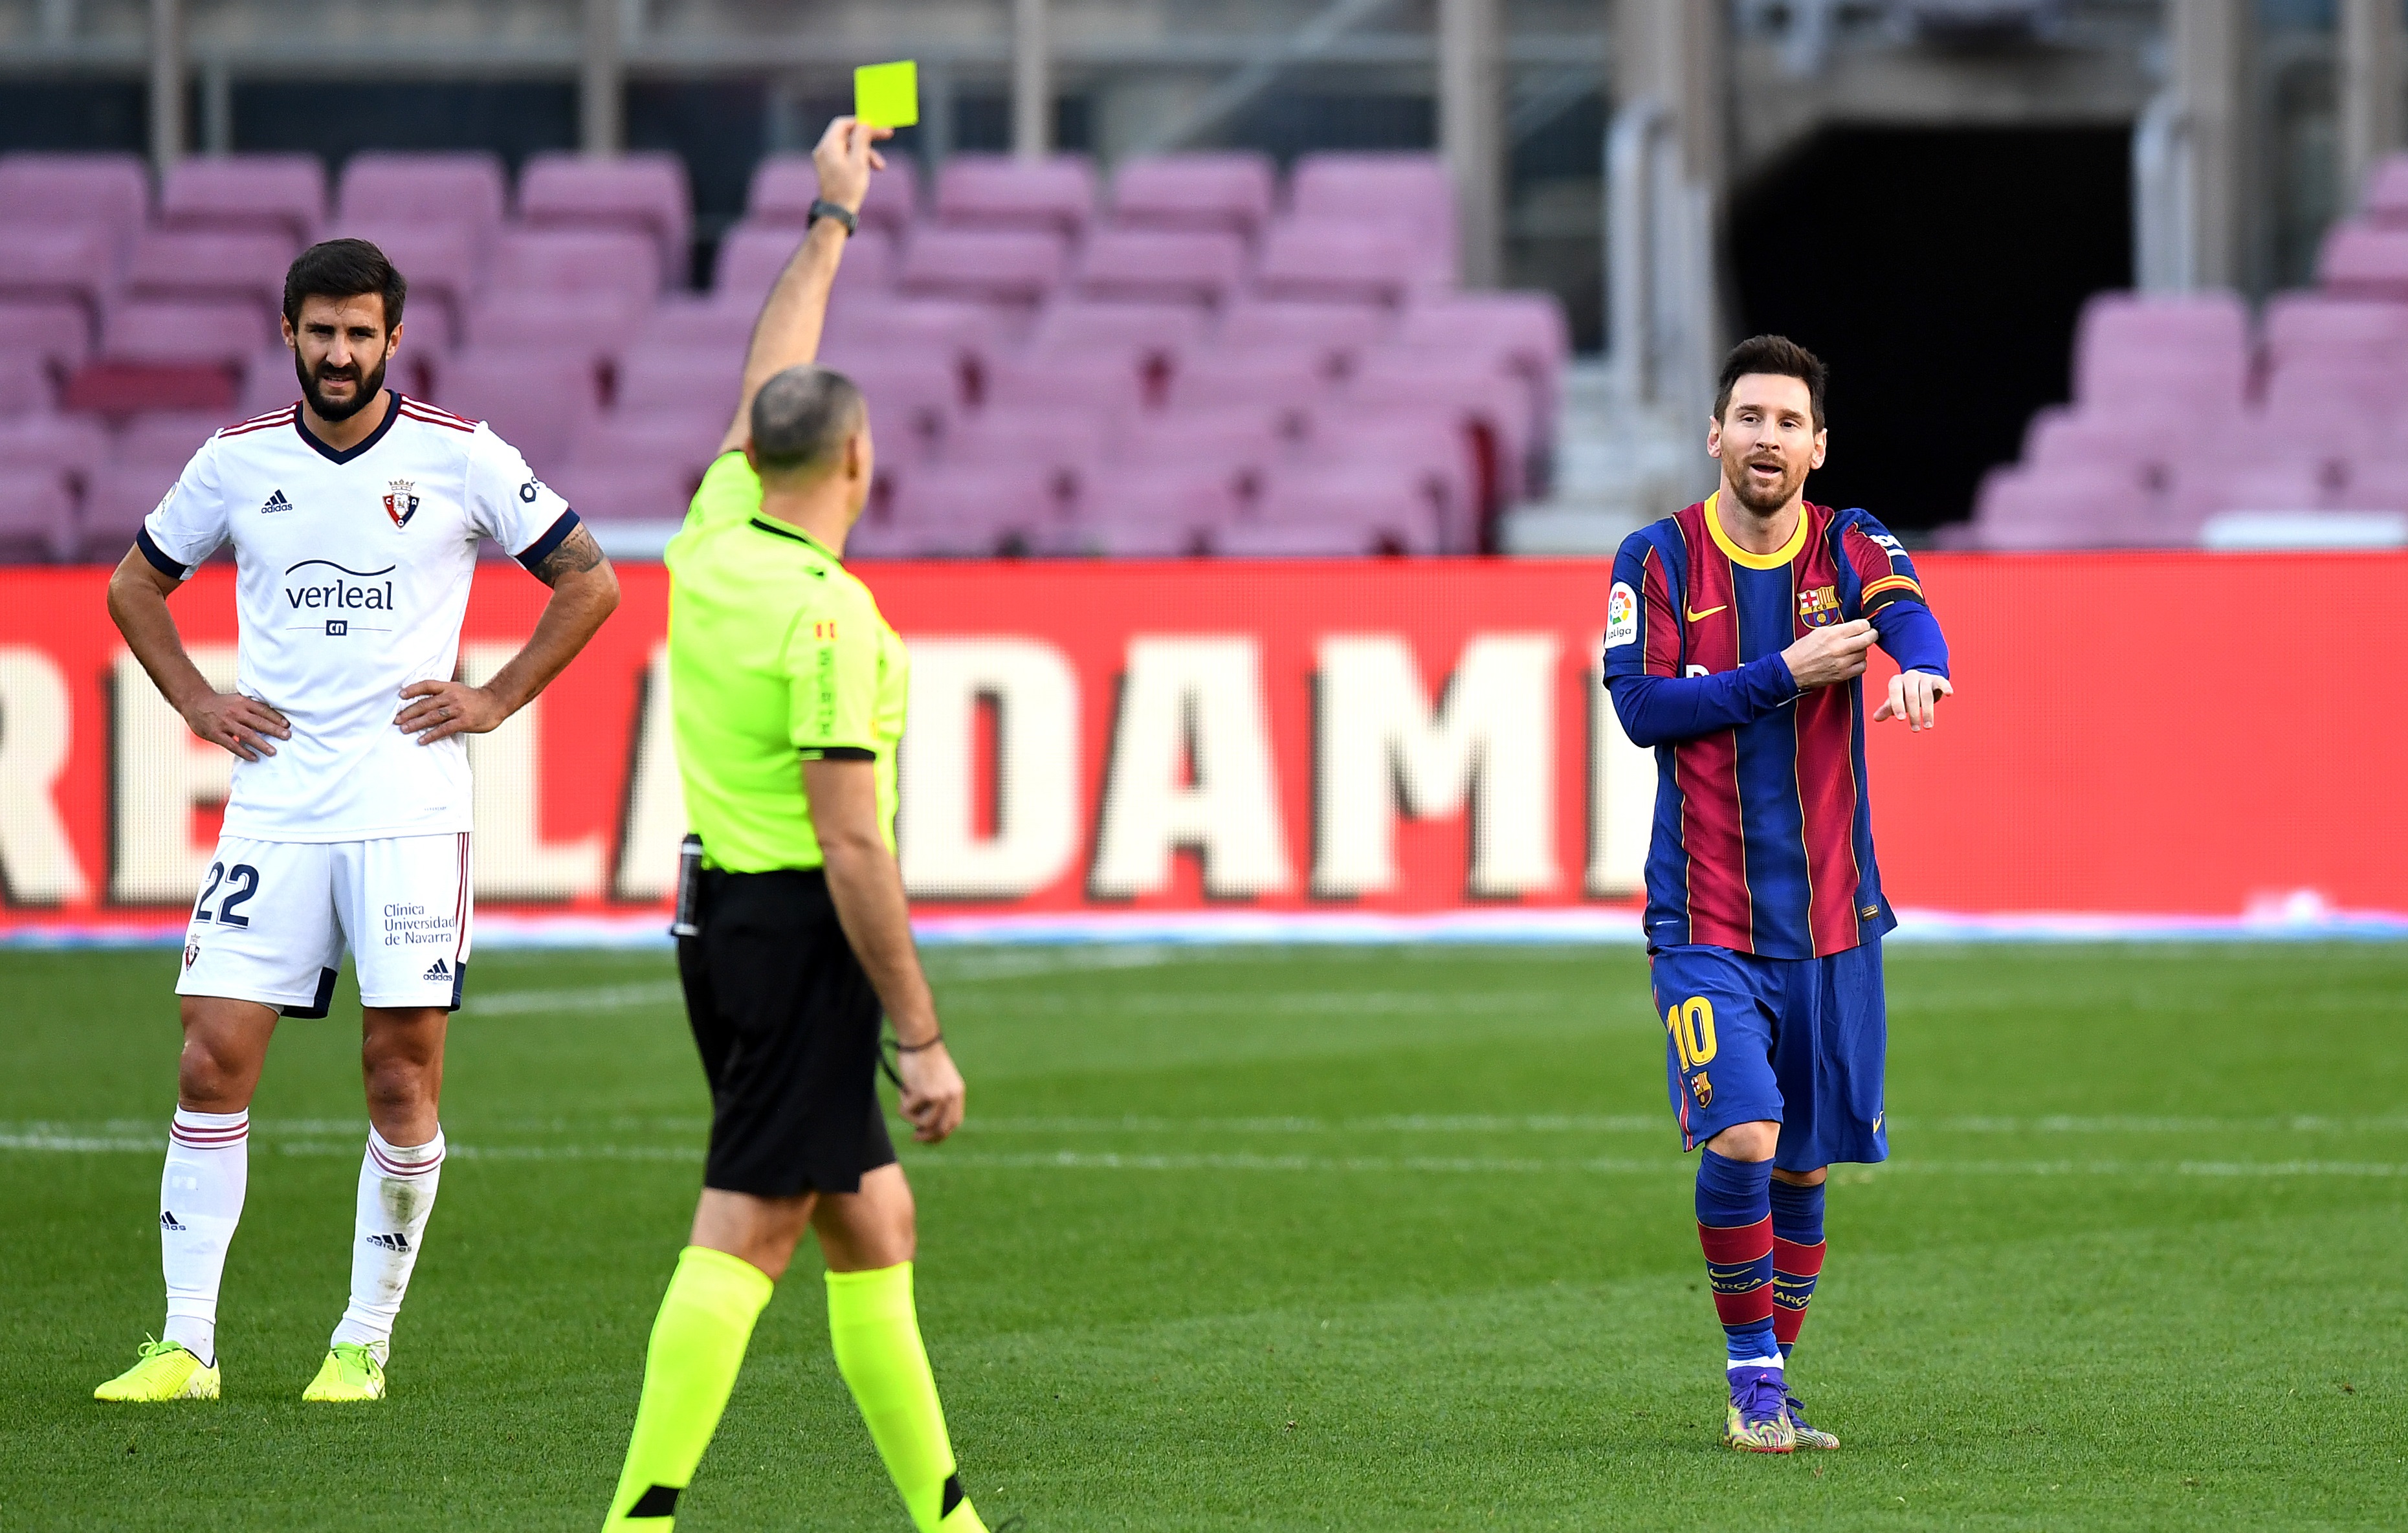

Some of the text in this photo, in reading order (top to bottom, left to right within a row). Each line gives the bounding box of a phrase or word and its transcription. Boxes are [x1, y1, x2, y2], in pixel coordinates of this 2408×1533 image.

[261, 503, 293, 514] adidas
[285, 579, 393, 610] verleal
[193, 861, 259, 930] 22
[384, 916, 454, 931] Universidad
[385, 931, 452, 945] de Navarra
[423, 973, 453, 982] adidas
[1666, 996, 1718, 1074] 10
[366, 1237, 412, 1252] adidas
[1773, 1290, 1811, 1307] ARÇA
